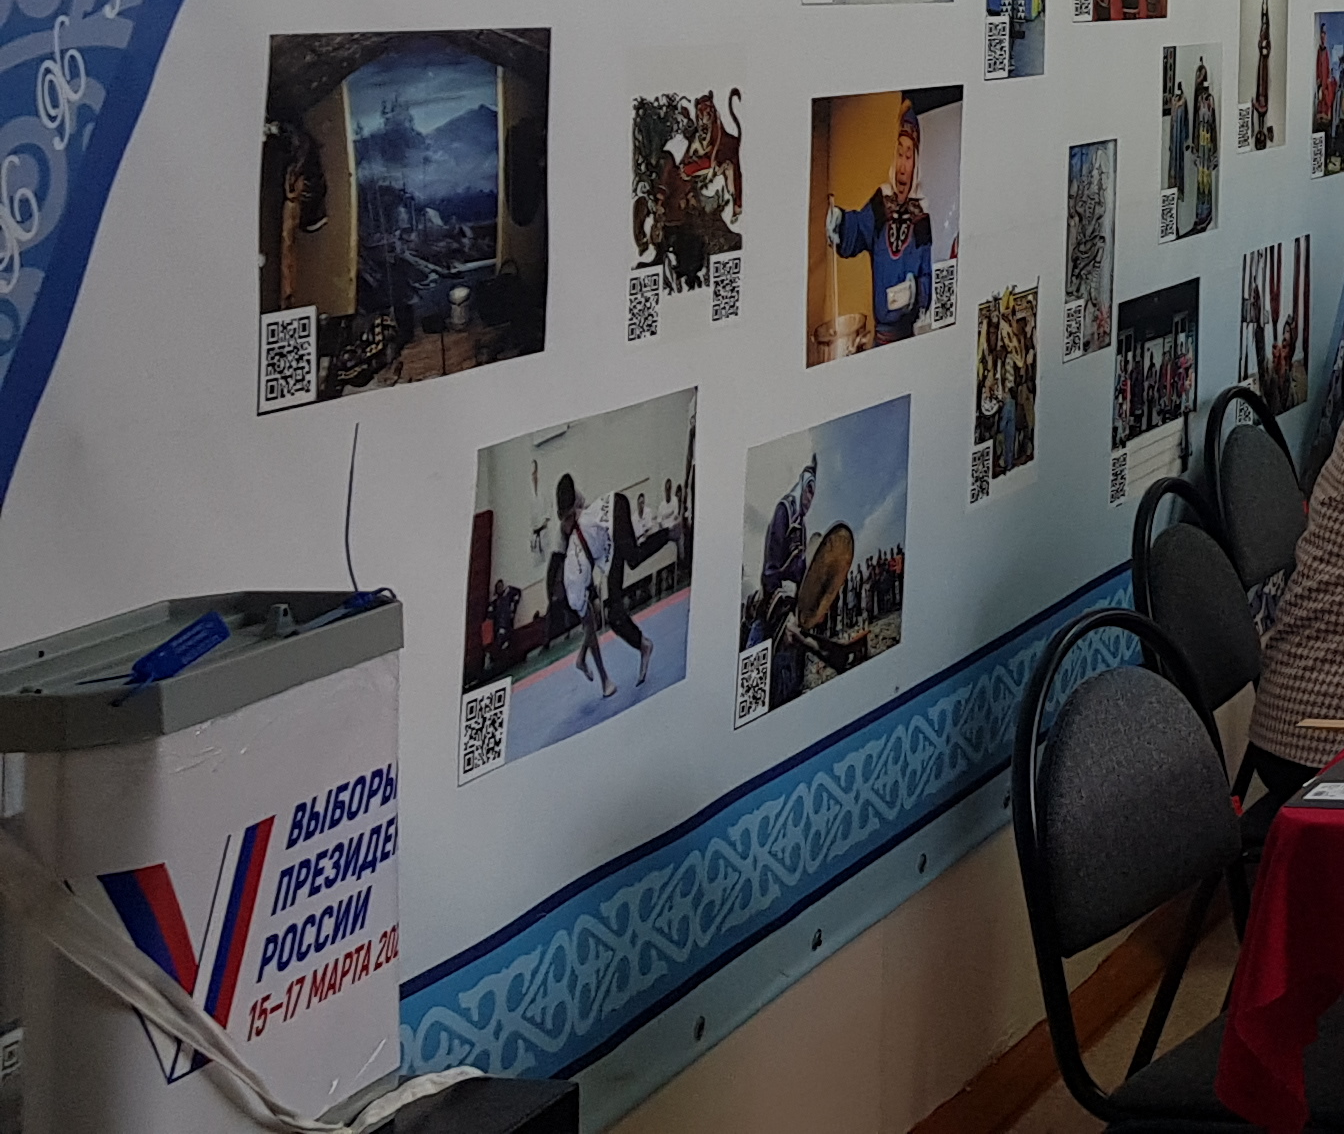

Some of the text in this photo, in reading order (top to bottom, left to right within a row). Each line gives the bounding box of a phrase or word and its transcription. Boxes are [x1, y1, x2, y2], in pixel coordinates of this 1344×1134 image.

[285, 762, 398, 851] ВЫБОРЫ
[256, 884, 373, 984] РОССИИ
[305, 939, 373, 1011] МАРТА
